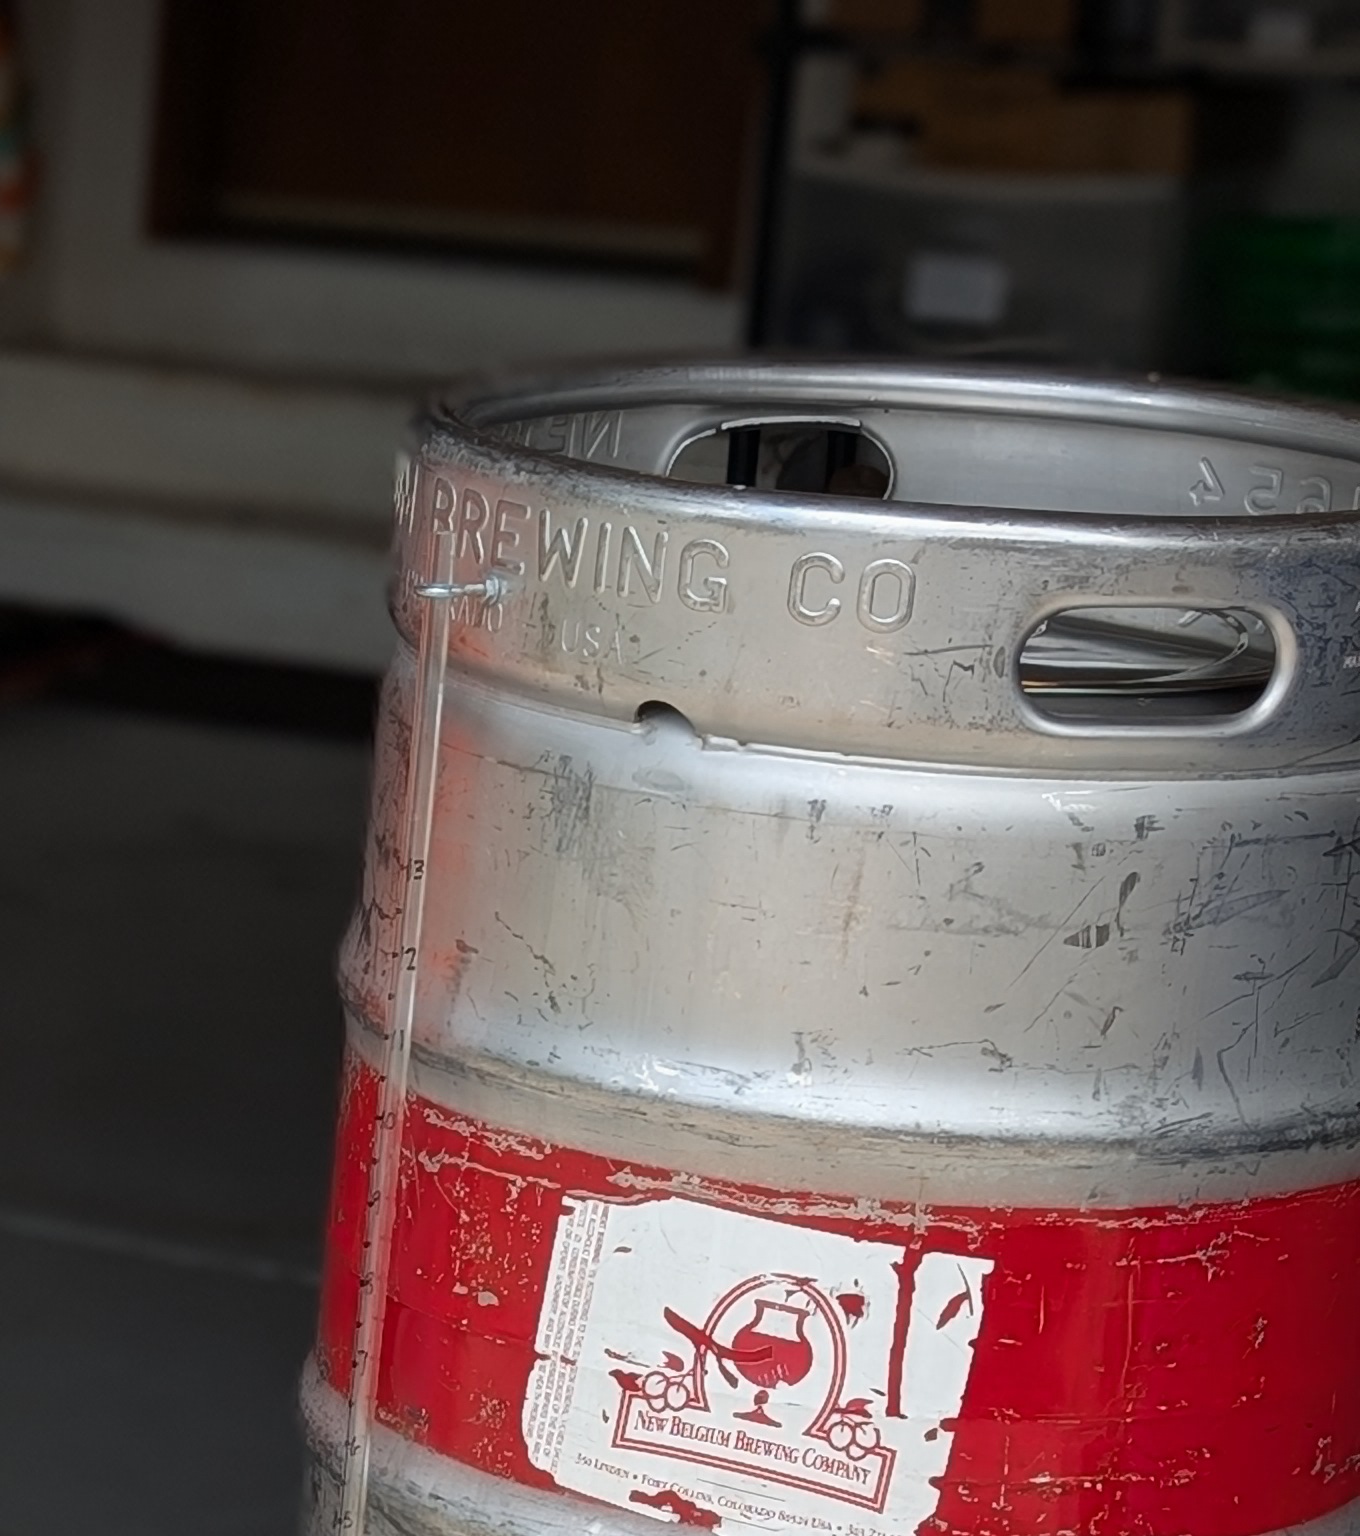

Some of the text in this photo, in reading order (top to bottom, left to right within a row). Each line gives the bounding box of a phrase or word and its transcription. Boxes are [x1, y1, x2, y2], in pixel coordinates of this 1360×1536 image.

[431, 476, 731, 614] BREWING
[787, 550, 917, 634] CO
[634, 1409, 872, 1485] NEW BELGIUM BREWING COMPANY
